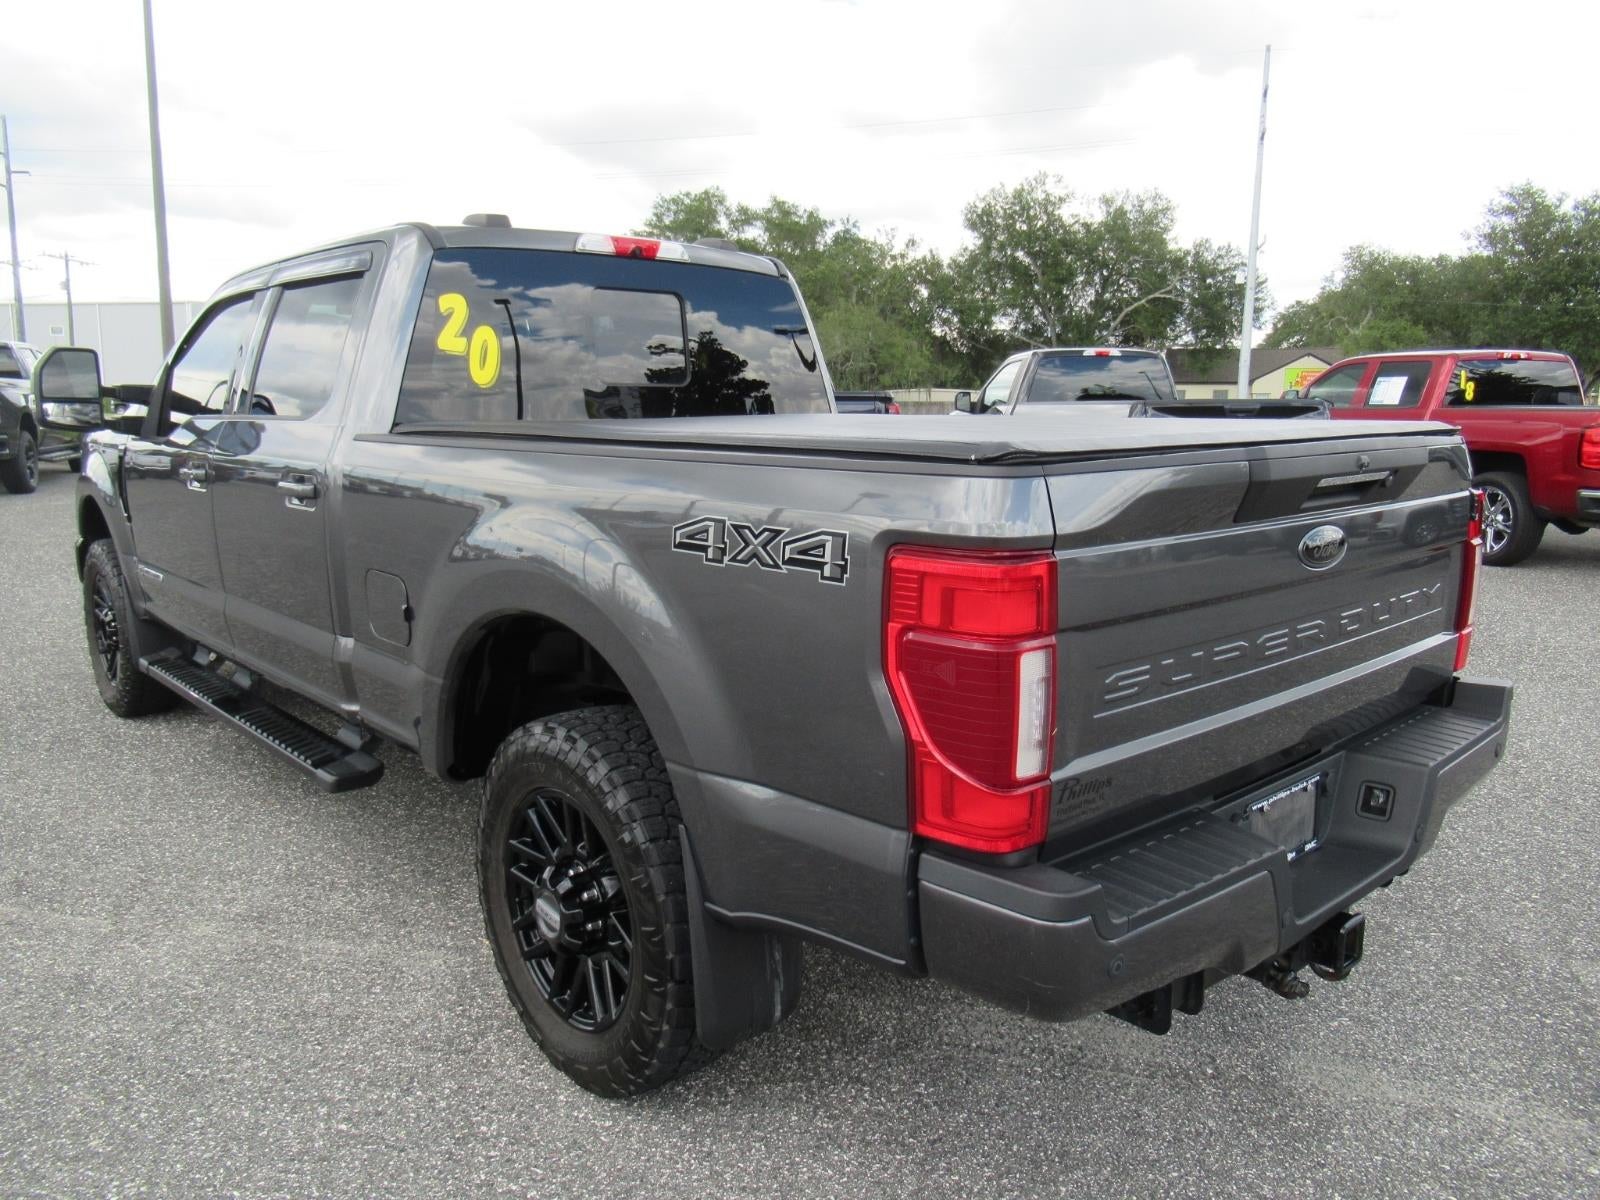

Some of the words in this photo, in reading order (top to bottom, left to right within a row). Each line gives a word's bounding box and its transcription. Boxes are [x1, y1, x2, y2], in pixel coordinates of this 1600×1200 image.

[437, 293, 501, 388] 20
[1102, 618, 1326, 704] SUPER
[1338, 582, 1442, 636] DUTY
[1055, 777, 1112, 804] Phillips
